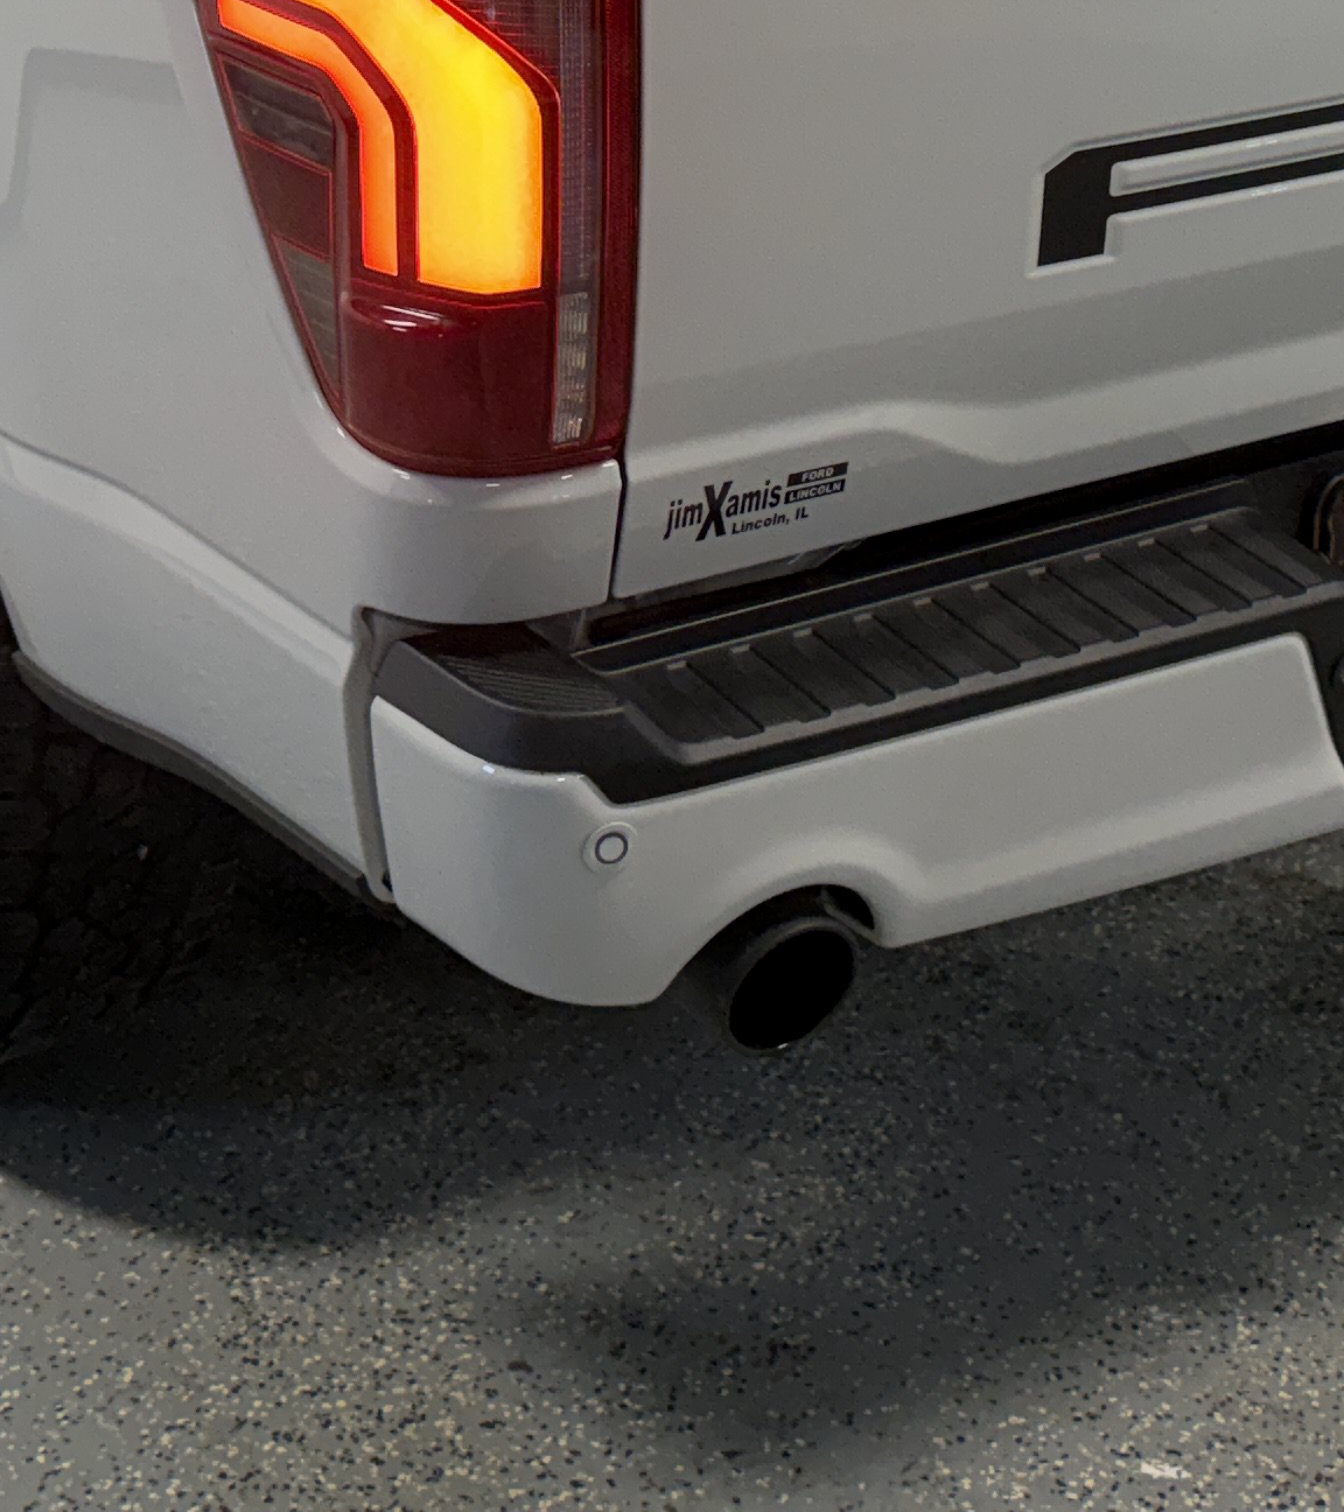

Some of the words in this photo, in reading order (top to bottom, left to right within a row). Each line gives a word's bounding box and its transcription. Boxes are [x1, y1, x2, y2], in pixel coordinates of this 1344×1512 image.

[801, 467, 834, 483] FORD
[732, 513, 789, 535] Lincoln,
[795, 506, 809, 521] IL
